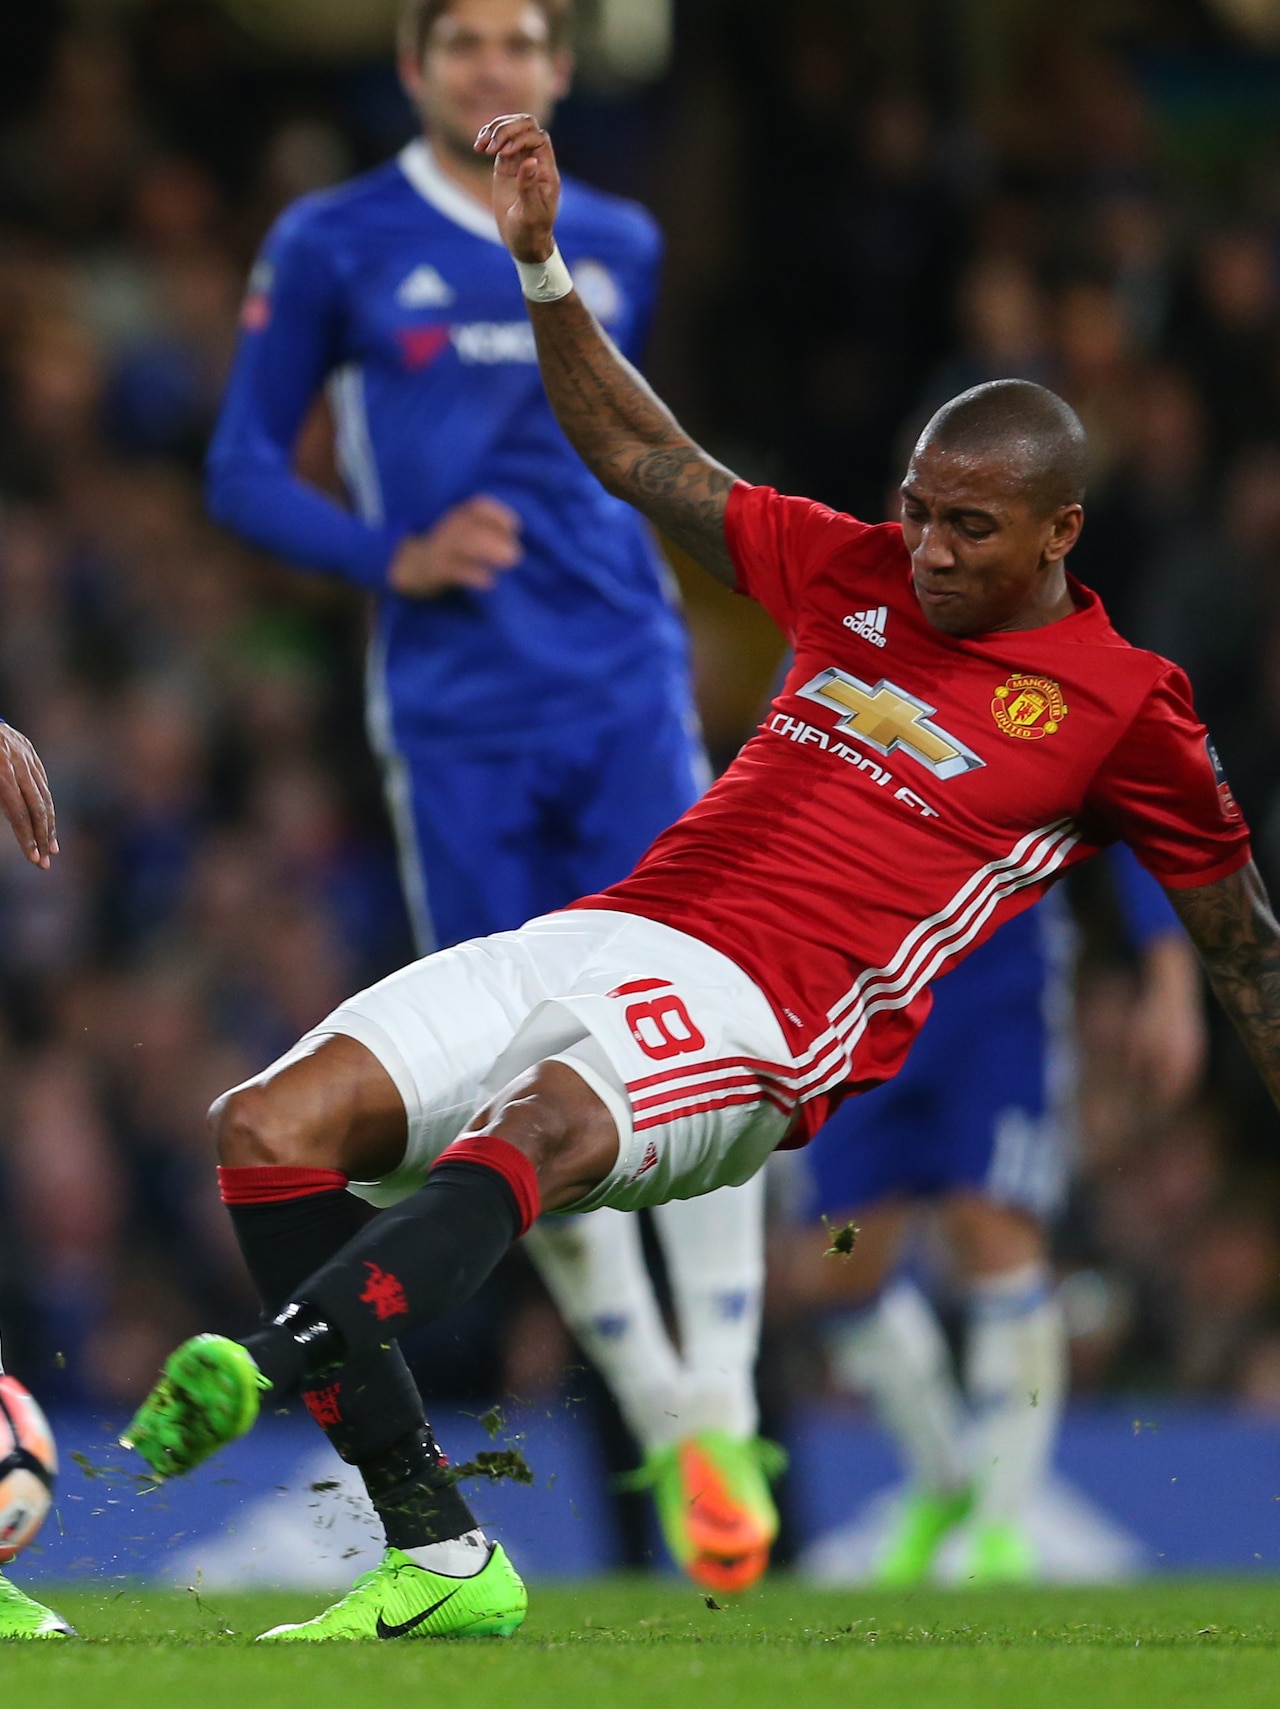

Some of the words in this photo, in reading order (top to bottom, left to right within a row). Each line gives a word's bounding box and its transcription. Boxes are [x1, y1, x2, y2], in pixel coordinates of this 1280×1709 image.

[842, 614, 887, 648] adidas
[1012, 679, 1061, 717] MANCHESTER
[995, 710, 1032, 738] UNITED
